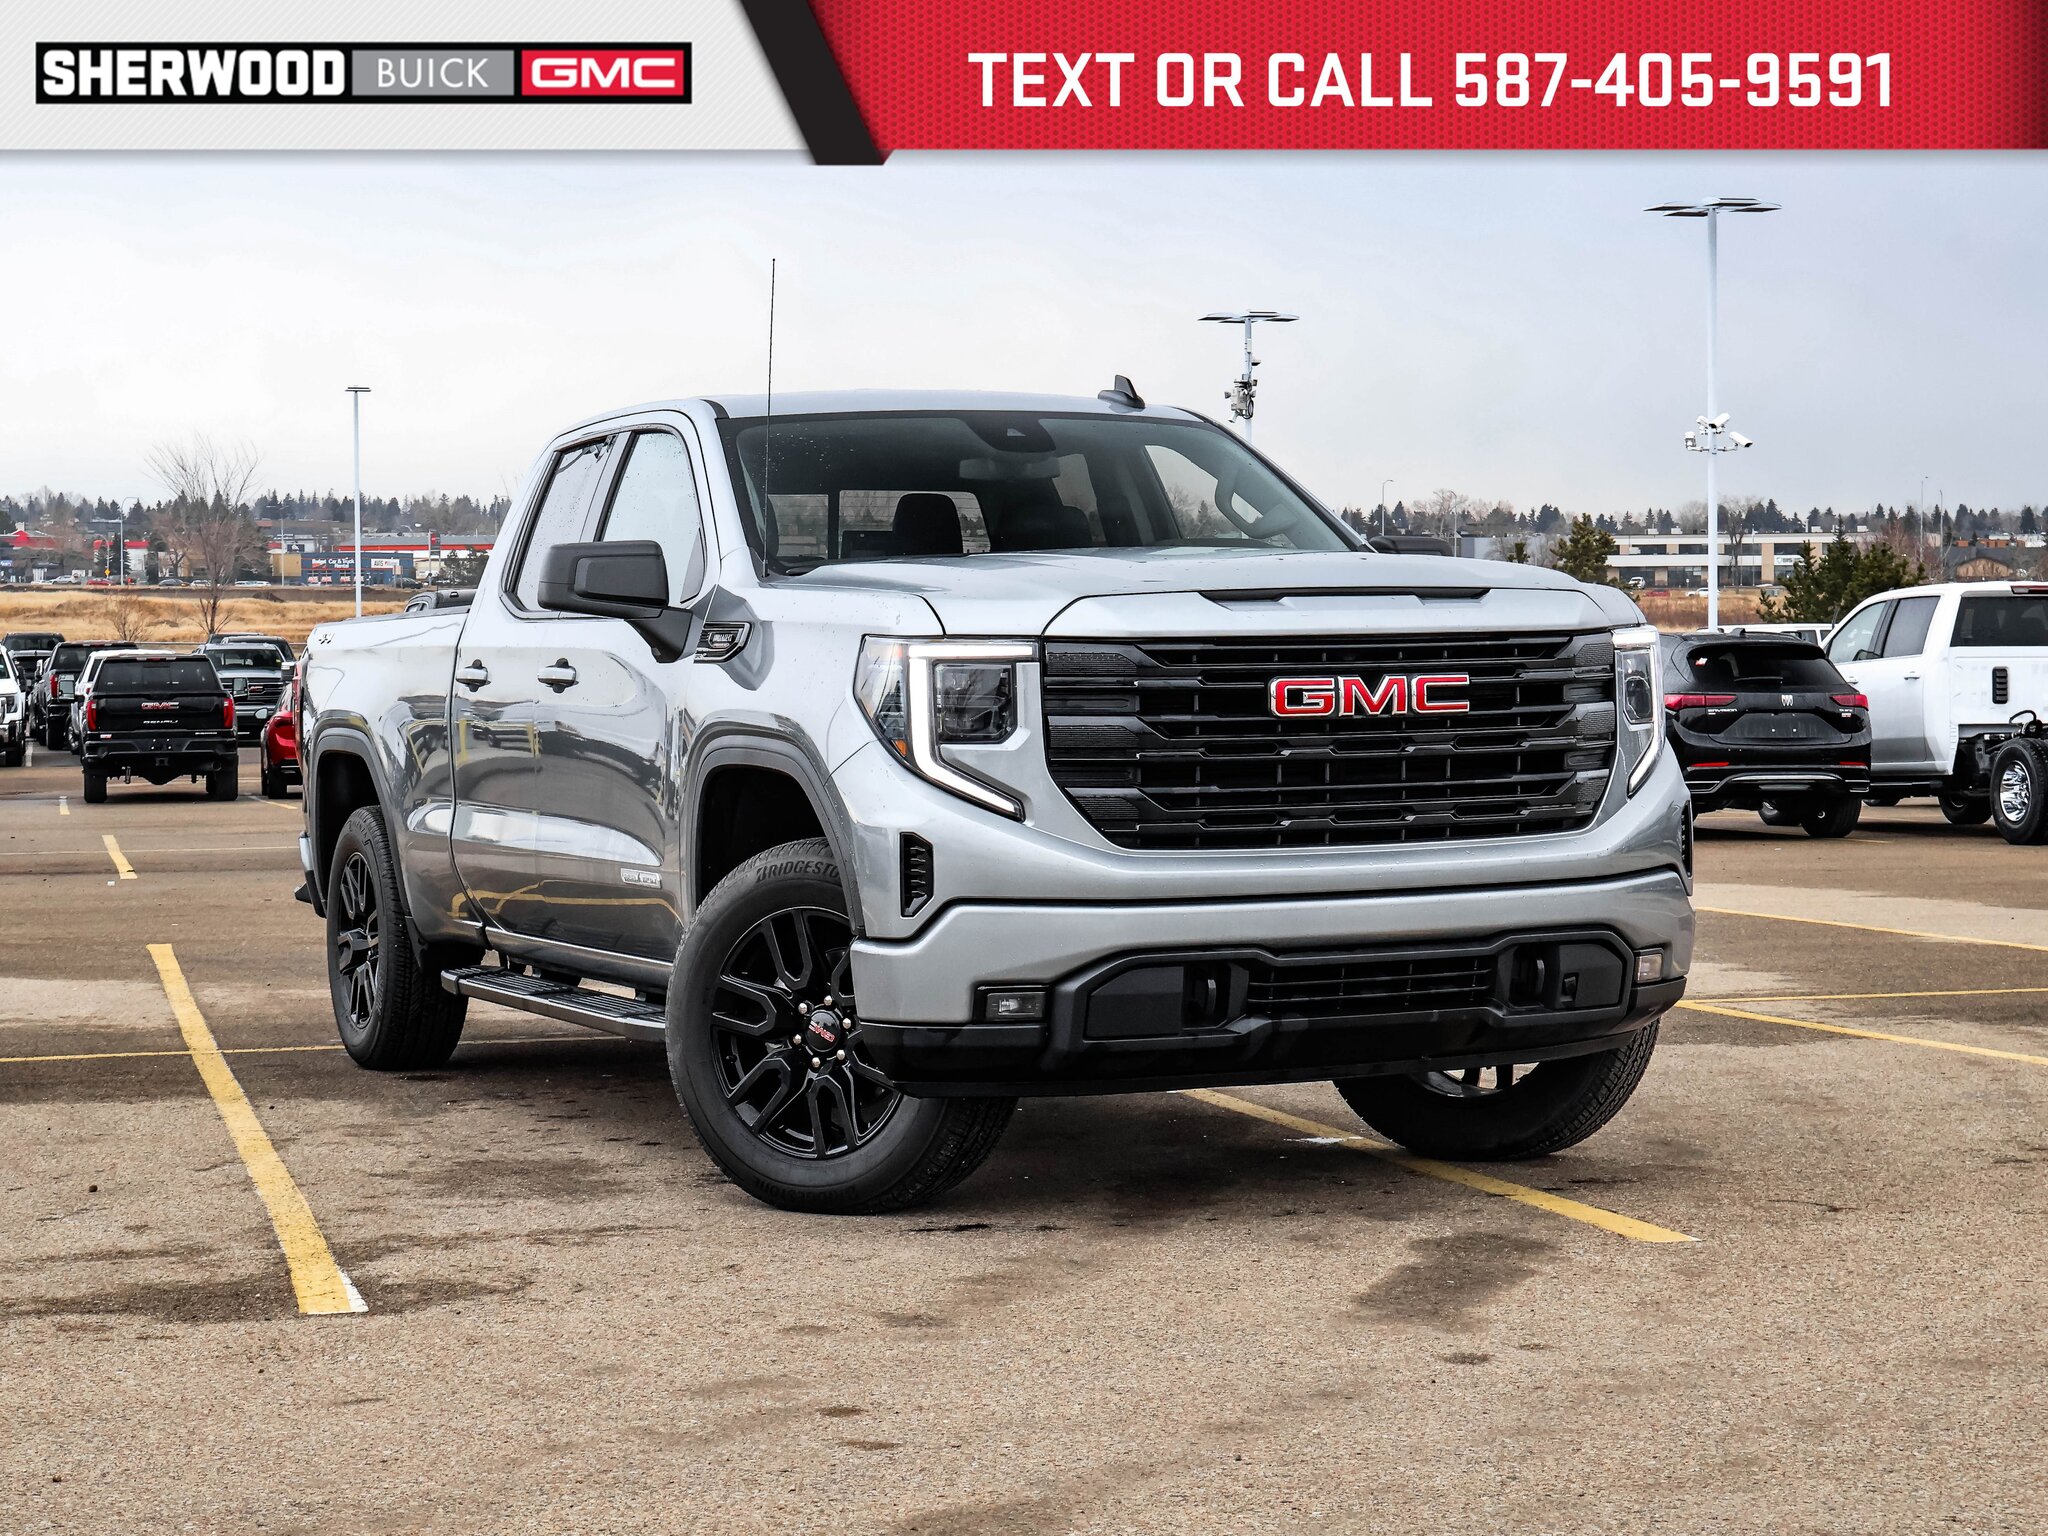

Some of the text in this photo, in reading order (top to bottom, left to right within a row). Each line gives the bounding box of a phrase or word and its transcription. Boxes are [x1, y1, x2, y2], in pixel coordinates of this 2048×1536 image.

[141, 701, 180, 710] GMC
[1269, 674, 1470, 717] GMC
[755, 860, 841, 883] BRIDGESTO
[809, 1020, 836, 1042] GMC
